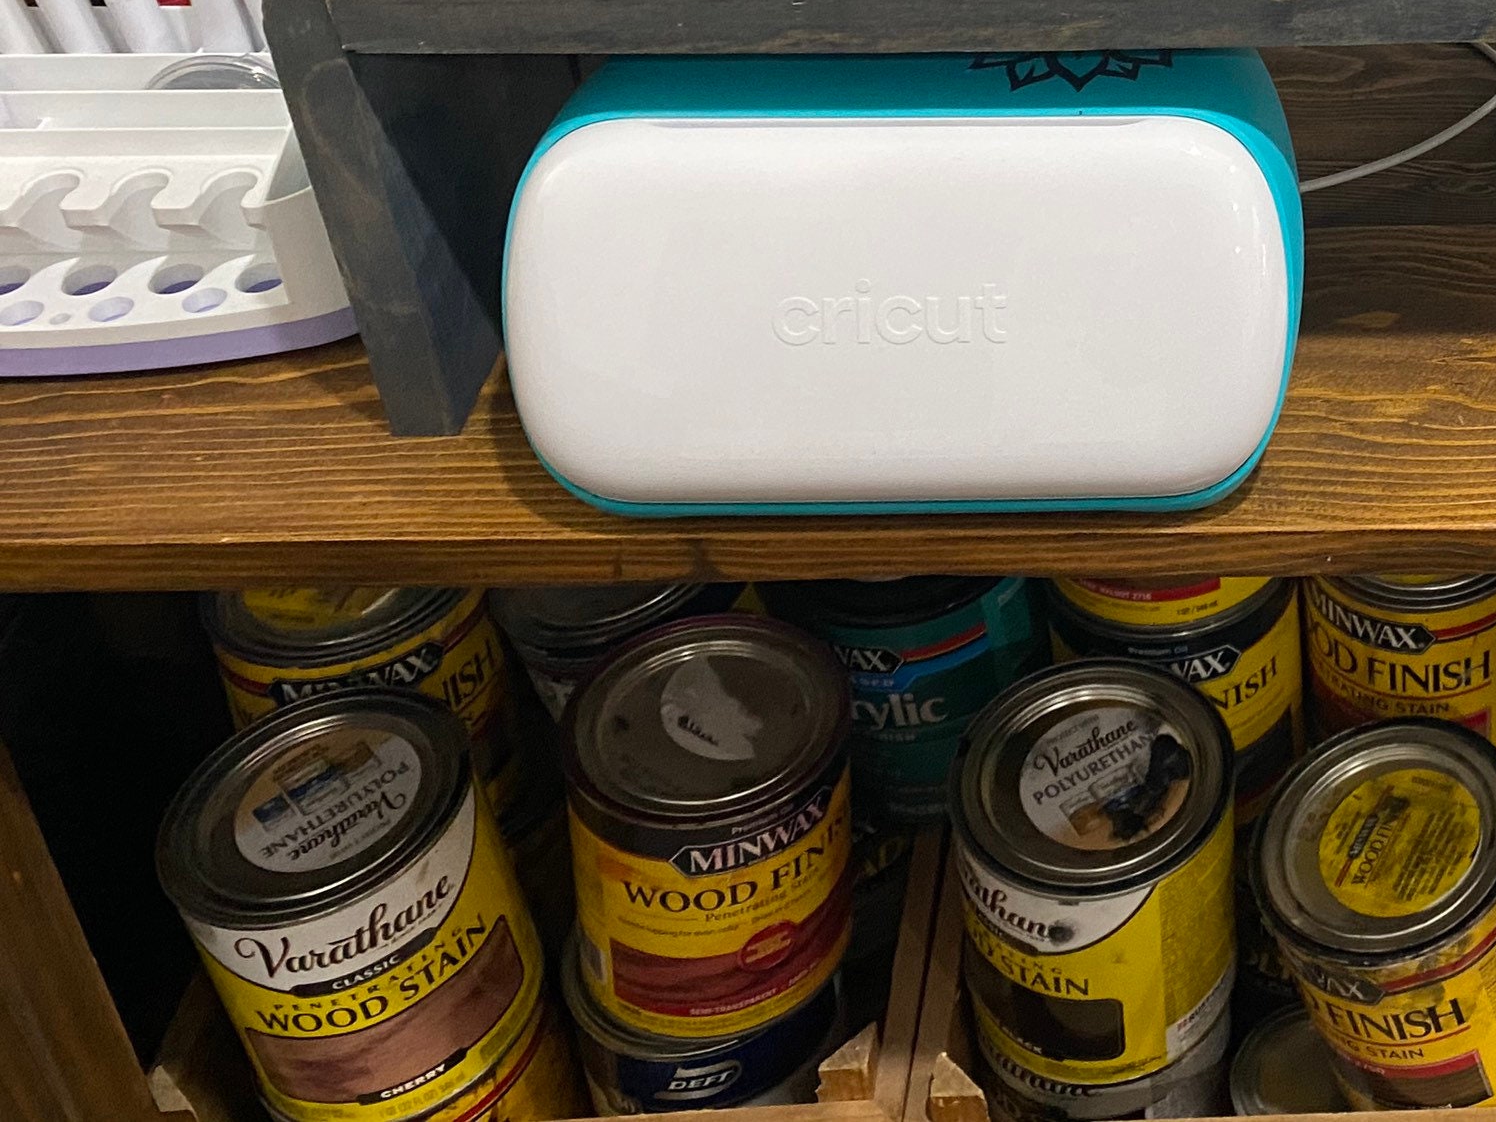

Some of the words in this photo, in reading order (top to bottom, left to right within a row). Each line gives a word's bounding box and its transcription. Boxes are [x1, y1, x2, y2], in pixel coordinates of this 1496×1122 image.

[771, 278, 1008, 346] cricut
[1311, 582, 1420, 650] MINWAX
[1367, 649, 1491, 694] FINISH
[1394, 702, 1451, 715] STAIN
[1032, 727, 1157, 805] POLYURETHAN
[1033, 720, 1137, 776] Varathane
[259, 761, 410, 859] POLYURETHANE
[287, 790, 407, 862] Varathane
[689, 795, 828, 874] MINWAX
[621, 880, 758, 914] WOOD
[233, 875, 451, 978] Varathane
[256, 995, 389, 1033] WOOD
[400, 912, 486, 1001] STAIN
[274, 927, 462, 1012] PENETRATING
[331, 953, 400, 991] CLASSIC
[1001, 955, 1089, 996] STAIN
[1325, 997, 1467, 1042] FINISH
[380, 1063, 446, 1099] CHERRY
[667, 1071, 730, 1091] DEFT
[1366, 1047, 1426, 1062] STAIN
